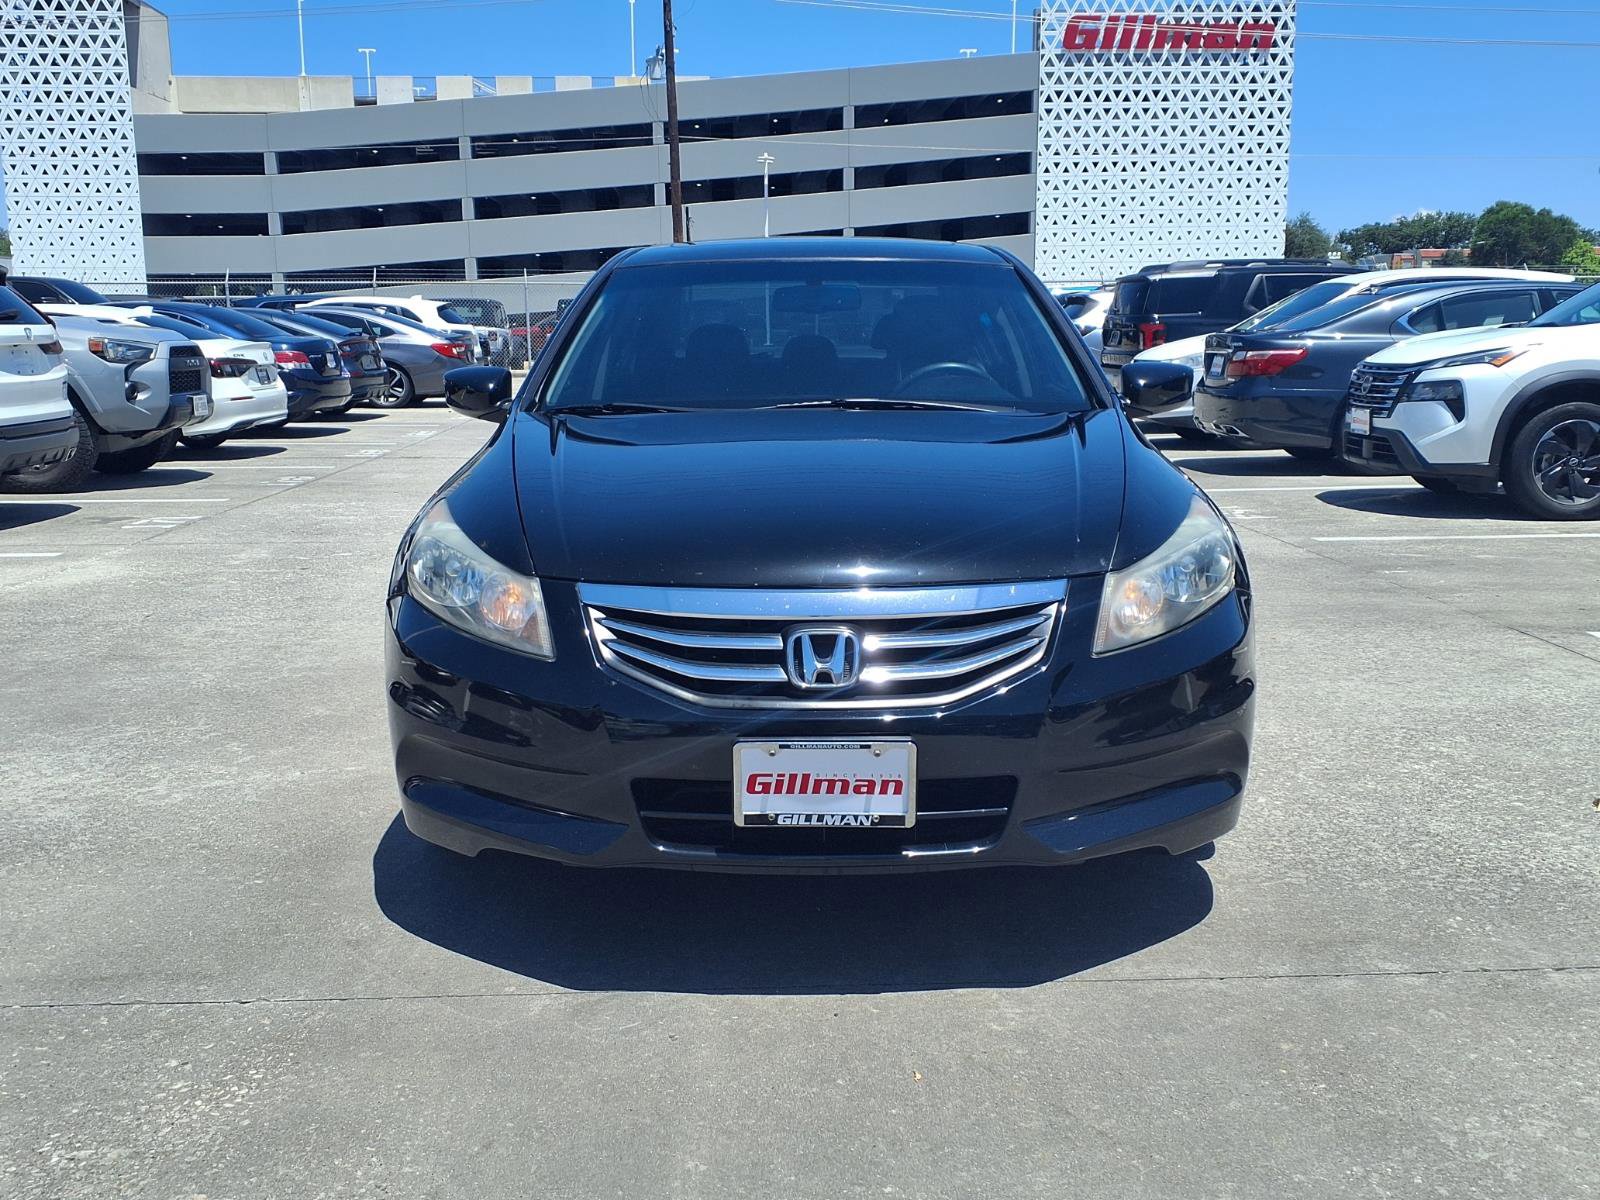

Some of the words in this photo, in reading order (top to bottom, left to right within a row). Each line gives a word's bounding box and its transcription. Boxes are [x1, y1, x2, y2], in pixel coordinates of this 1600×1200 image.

[1062, 15, 1276, 50] Gillman
[746, 773, 904, 796] Gillman
[777, 814, 873, 826] GILLMAN
